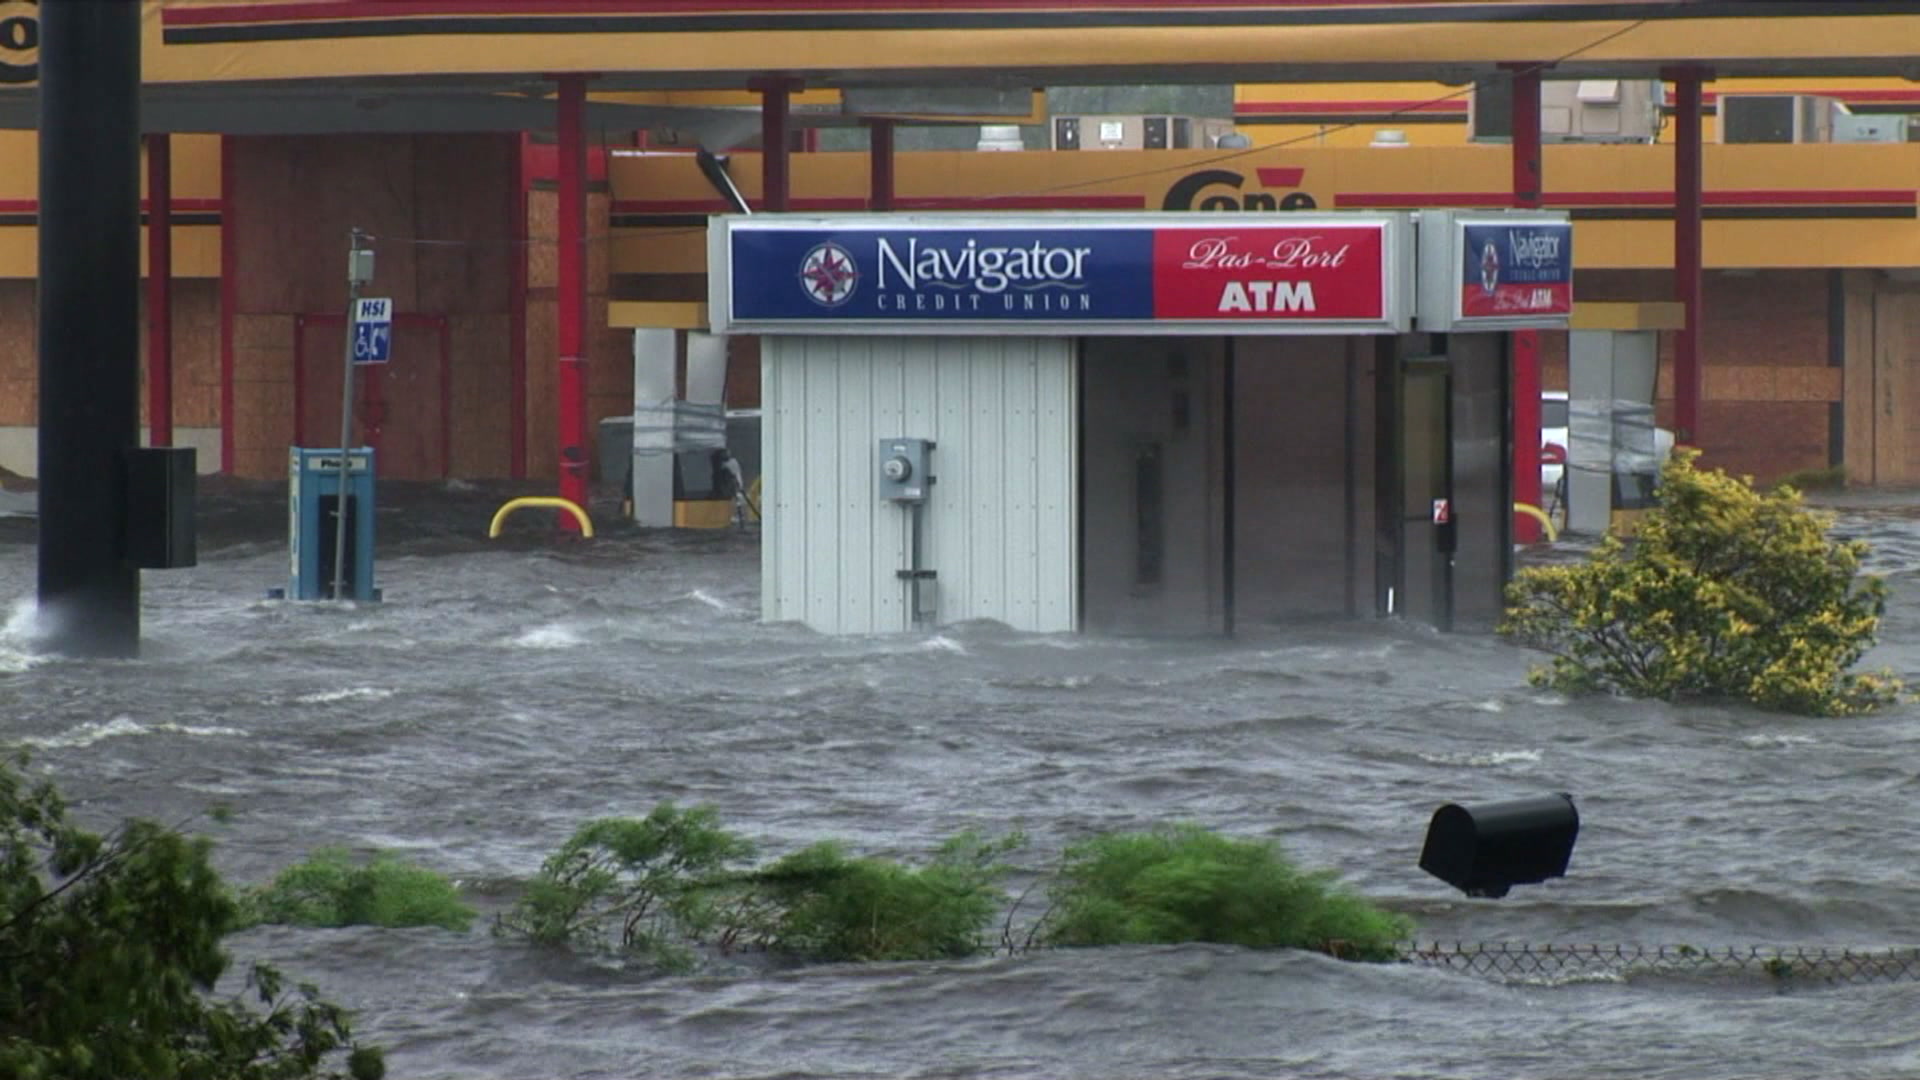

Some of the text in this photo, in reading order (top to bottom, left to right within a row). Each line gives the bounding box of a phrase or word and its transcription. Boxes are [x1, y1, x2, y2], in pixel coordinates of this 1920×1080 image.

[1182, 236, 1349, 269] Pas-Port
[1508, 228, 1560, 269] Navigator
[876, 237, 1091, 293] Navigator
[877, 294, 1091, 311] CREDIT UNION
[1217, 281, 1316, 312] ATM
[321, 458, 353, 469] Phoe
